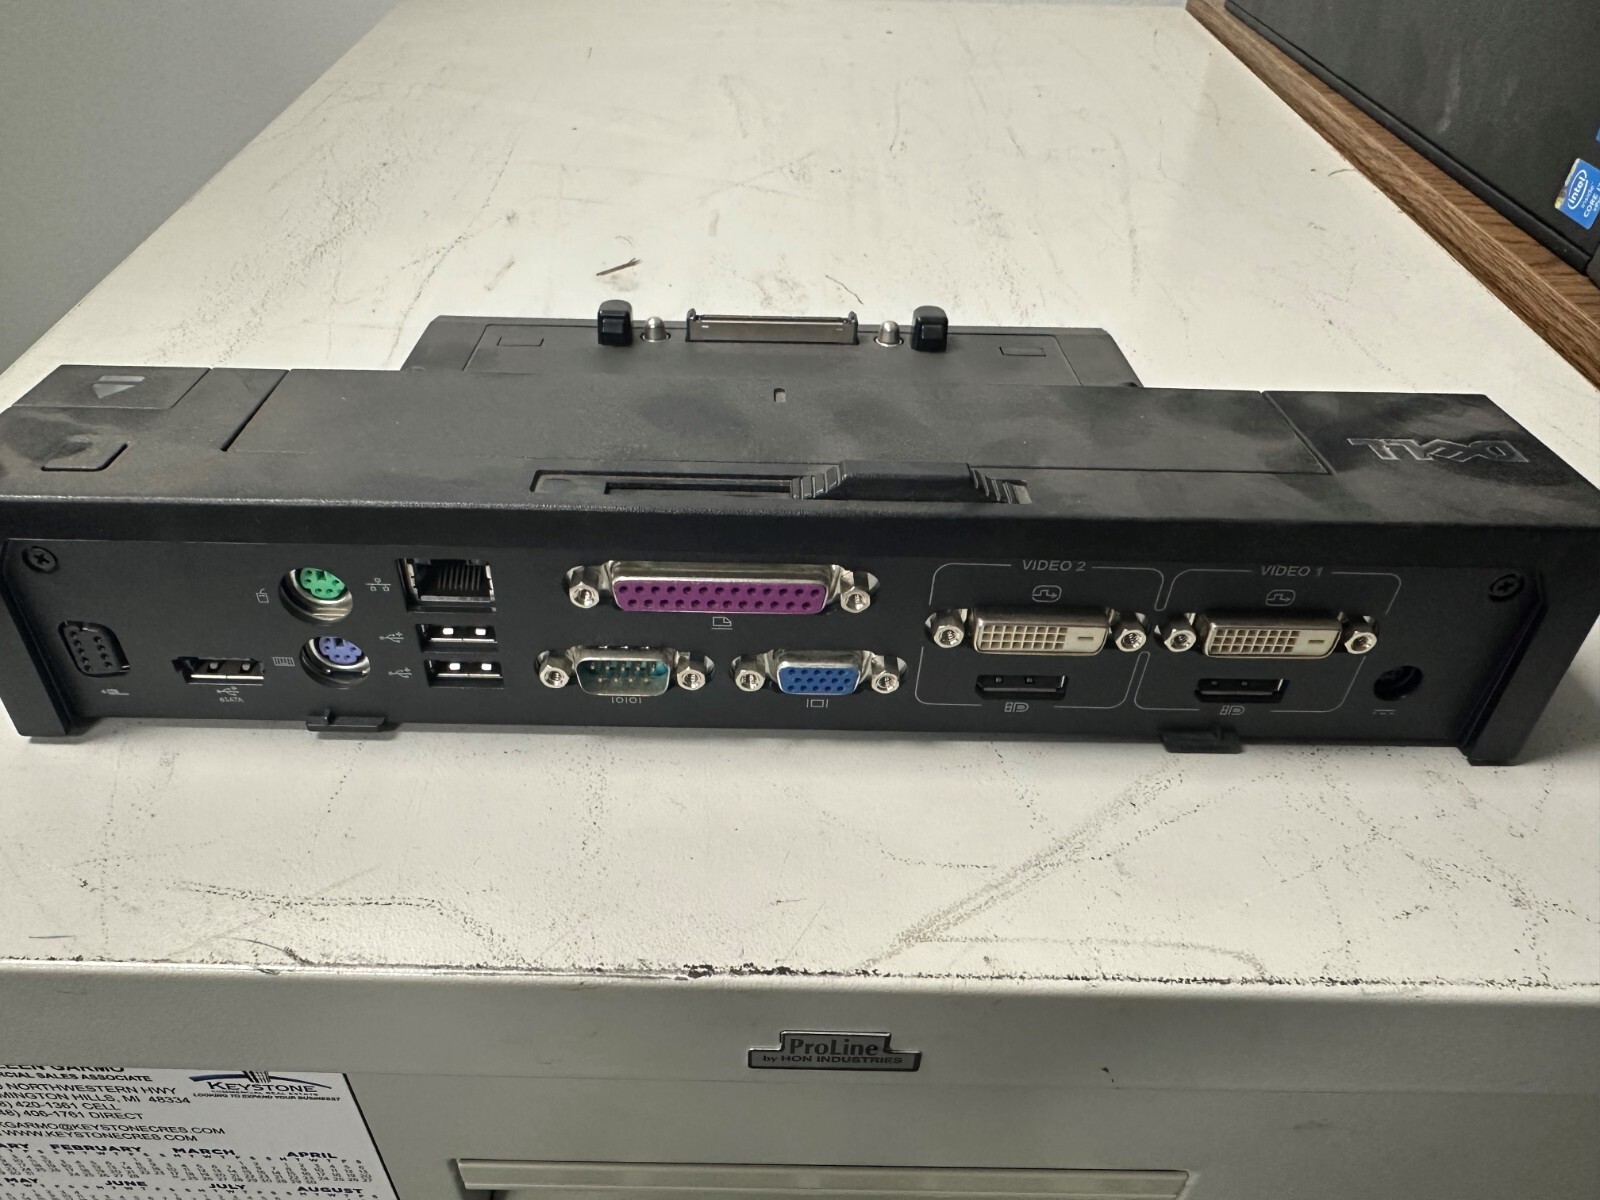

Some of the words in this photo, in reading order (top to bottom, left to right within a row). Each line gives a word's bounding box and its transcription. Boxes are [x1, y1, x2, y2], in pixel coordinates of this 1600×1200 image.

[1568, 176, 1587, 204] intel
[1583, 193, 1599, 218] CORE
[1347, 438, 1529, 463] DELL
[1022, 559, 1073, 572] VIDEO
[1075, 560, 1087, 572] 2
[1260, 564, 1311, 577] VIDEO
[1314, 566, 1324, 577] 1
[789, 1038, 879, 1056] ProLine
[763, 1055, 778, 1063] by
[781, 1055, 813, 1063] HON
[816, 1056, 903, 1064] INDUSTRIES
[36, 1072, 79, 1080] SALES
[82, 1073, 153, 1082] ASSOCIATE
[5, 1083, 139, 1094] NORTHWESTERN
[140, 1086, 177, 1095] HWY
[207, 1081, 318, 1093] KEYSTONE
[122, 1095, 141, 1103] MI
[149, 1096, 191, 1104] 48334
[82, 1102, 122, 1111] CELL
[88, 1112, 144, 1120] DIRECT
[50, 1144, 141, 1152] FEBRUARY
[172, 1147, 236, 1155] MARCH
[287, 1151, 338, 1159] APRIL
[297, 1186, 363, 1194] AUGUST
